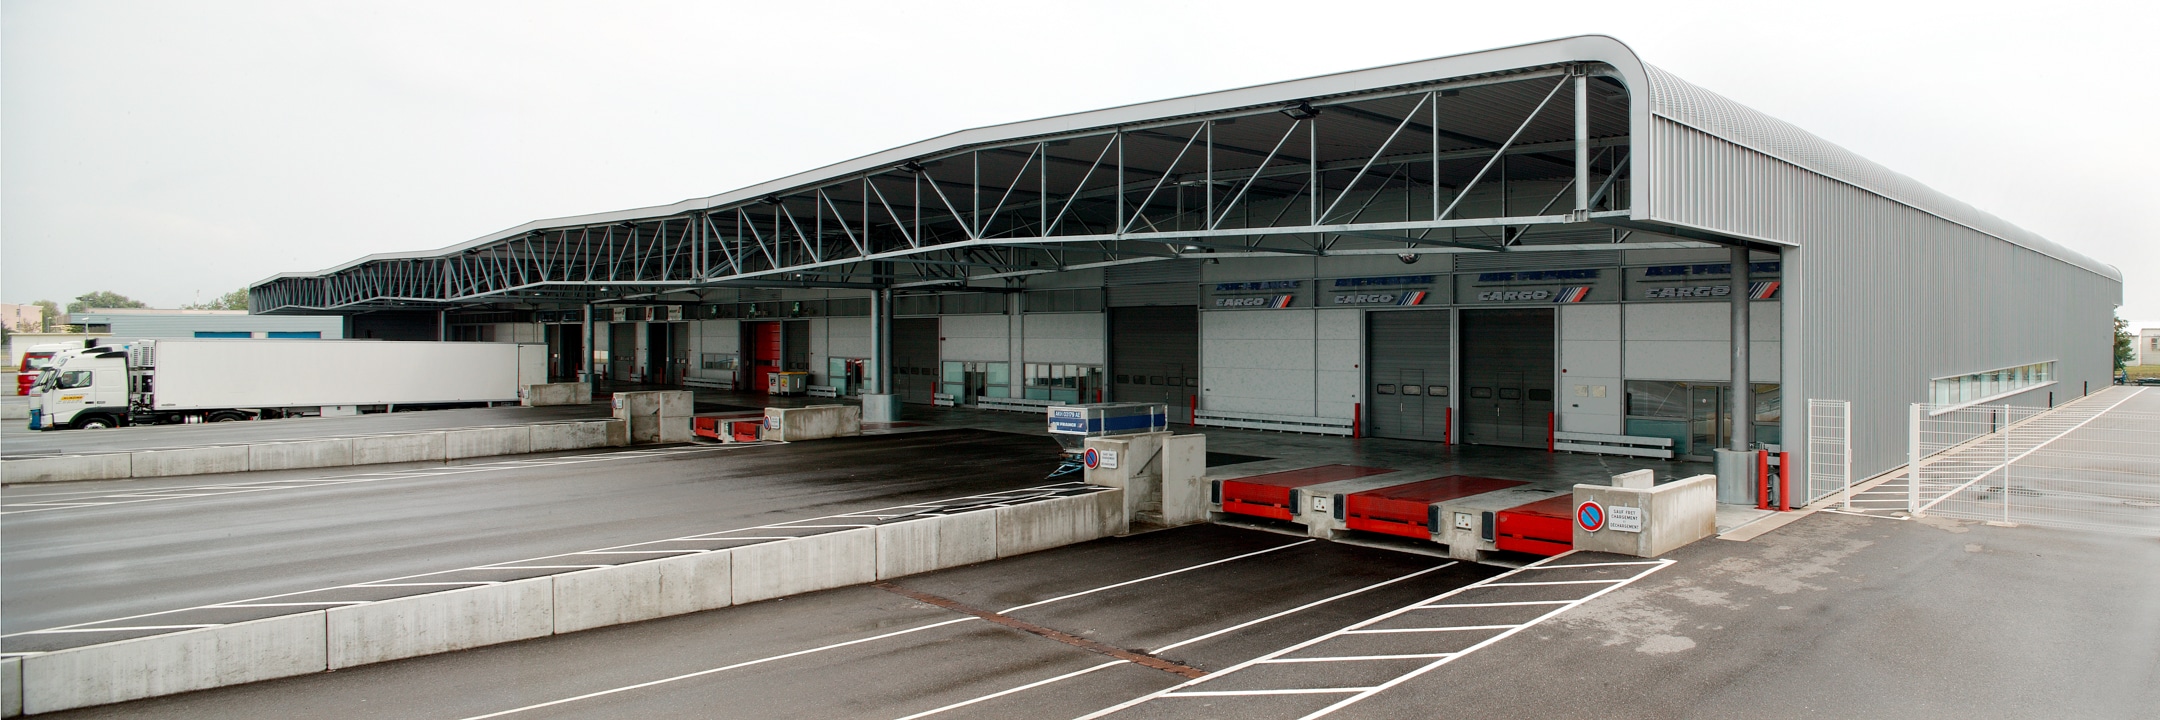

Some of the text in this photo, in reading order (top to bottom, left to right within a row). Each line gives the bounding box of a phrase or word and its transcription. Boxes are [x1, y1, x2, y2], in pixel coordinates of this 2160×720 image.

[1478, 290, 1548, 301] CARGO
[1644, 285, 1730, 298] CARGO
[1216, 297, 1264, 307] CARGO
[1334, 294, 1393, 304] CARGO
